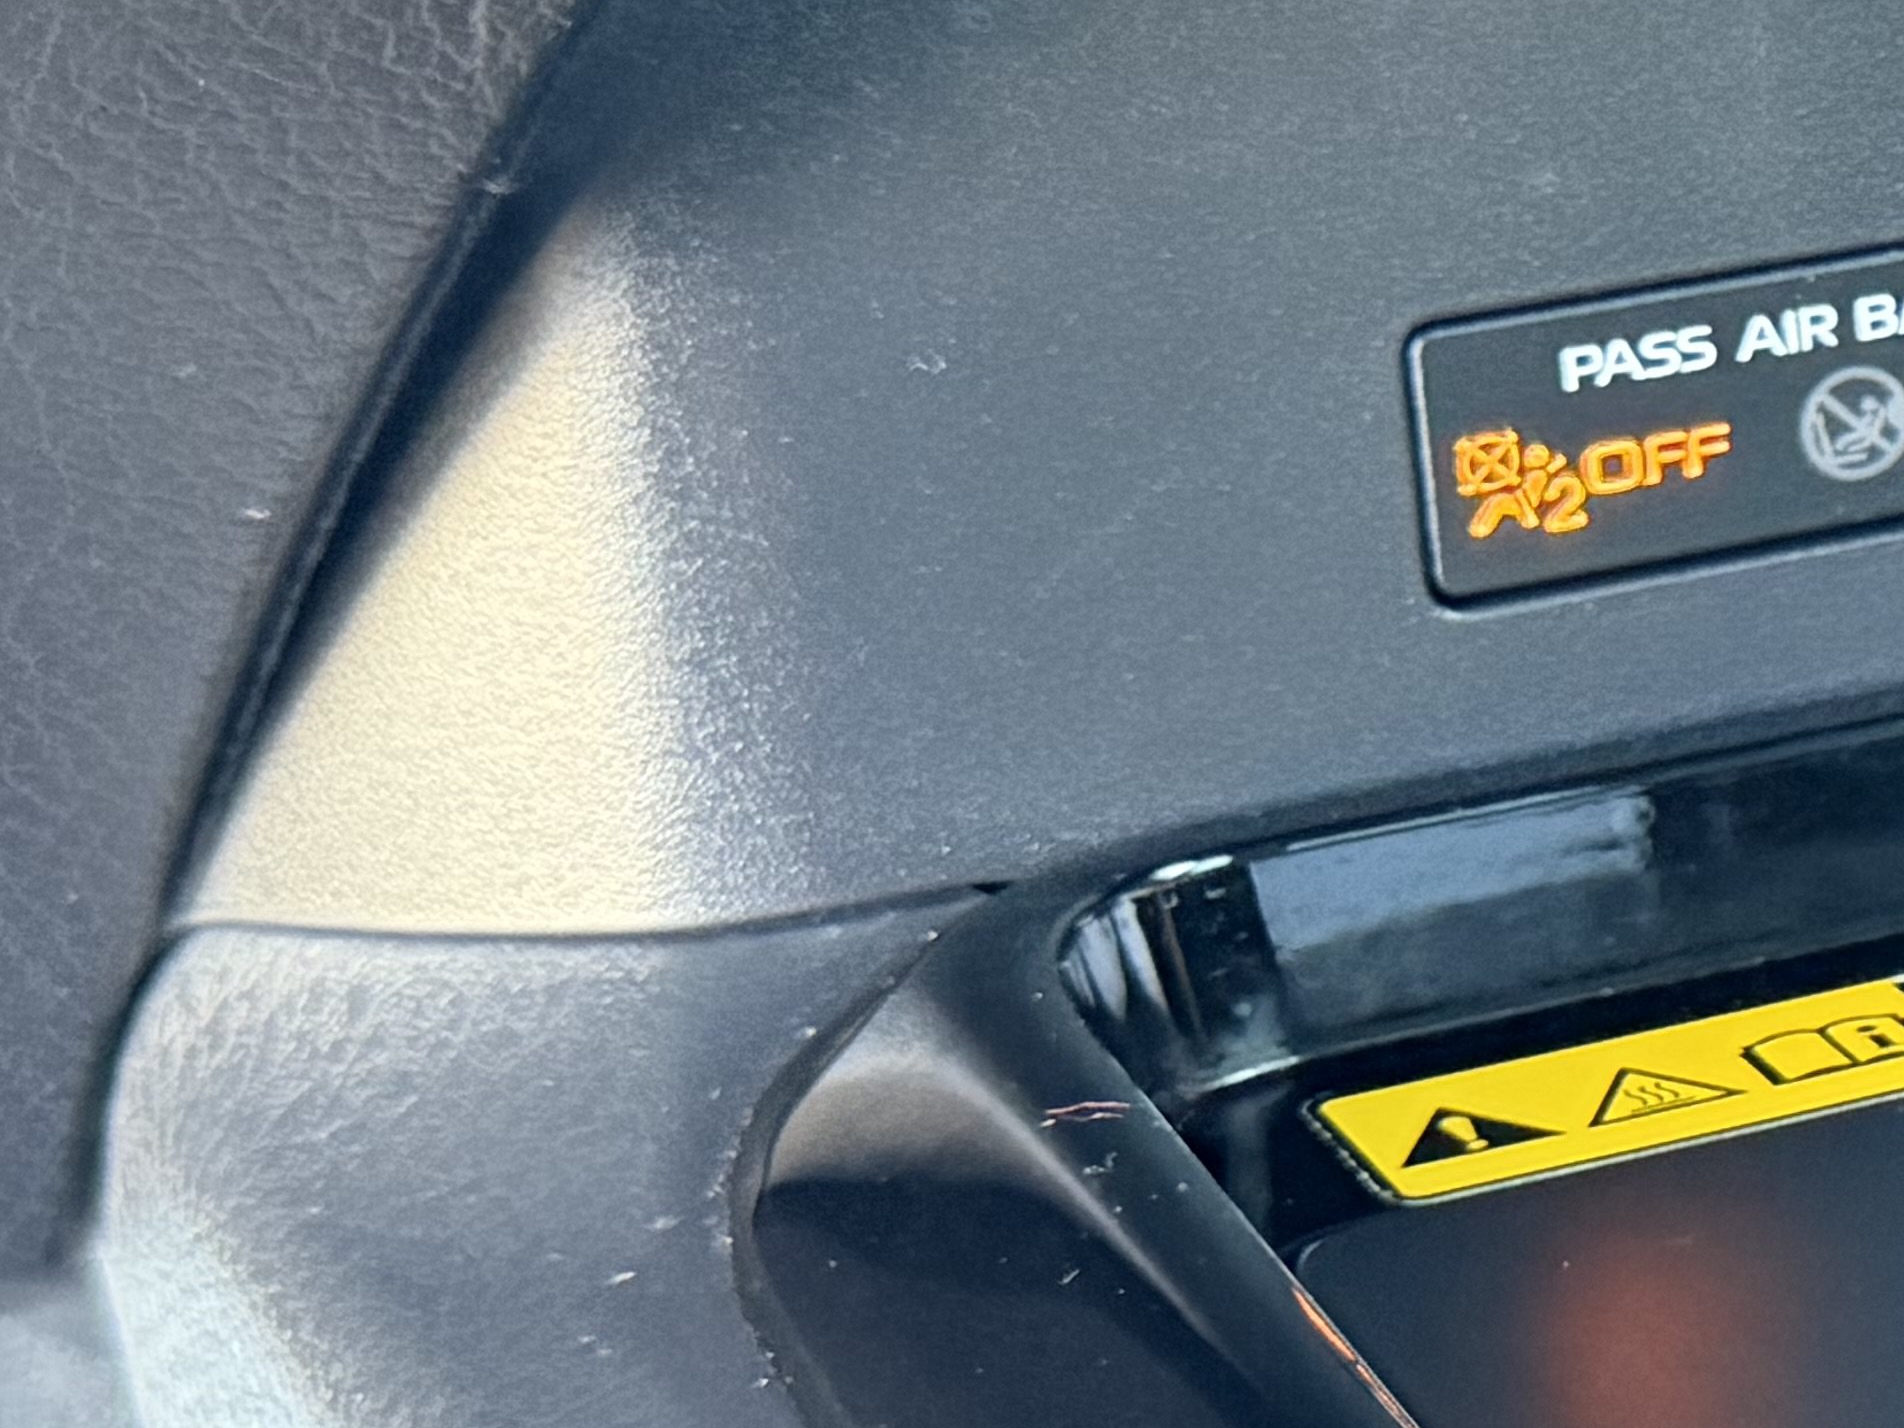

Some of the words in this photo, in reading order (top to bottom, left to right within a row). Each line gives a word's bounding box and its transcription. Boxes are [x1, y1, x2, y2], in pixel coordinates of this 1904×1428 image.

[1557, 325, 1718, 393] PASS
[1734, 304, 1839, 363] AIR
[1580, 421, 1732, 497] OFF
